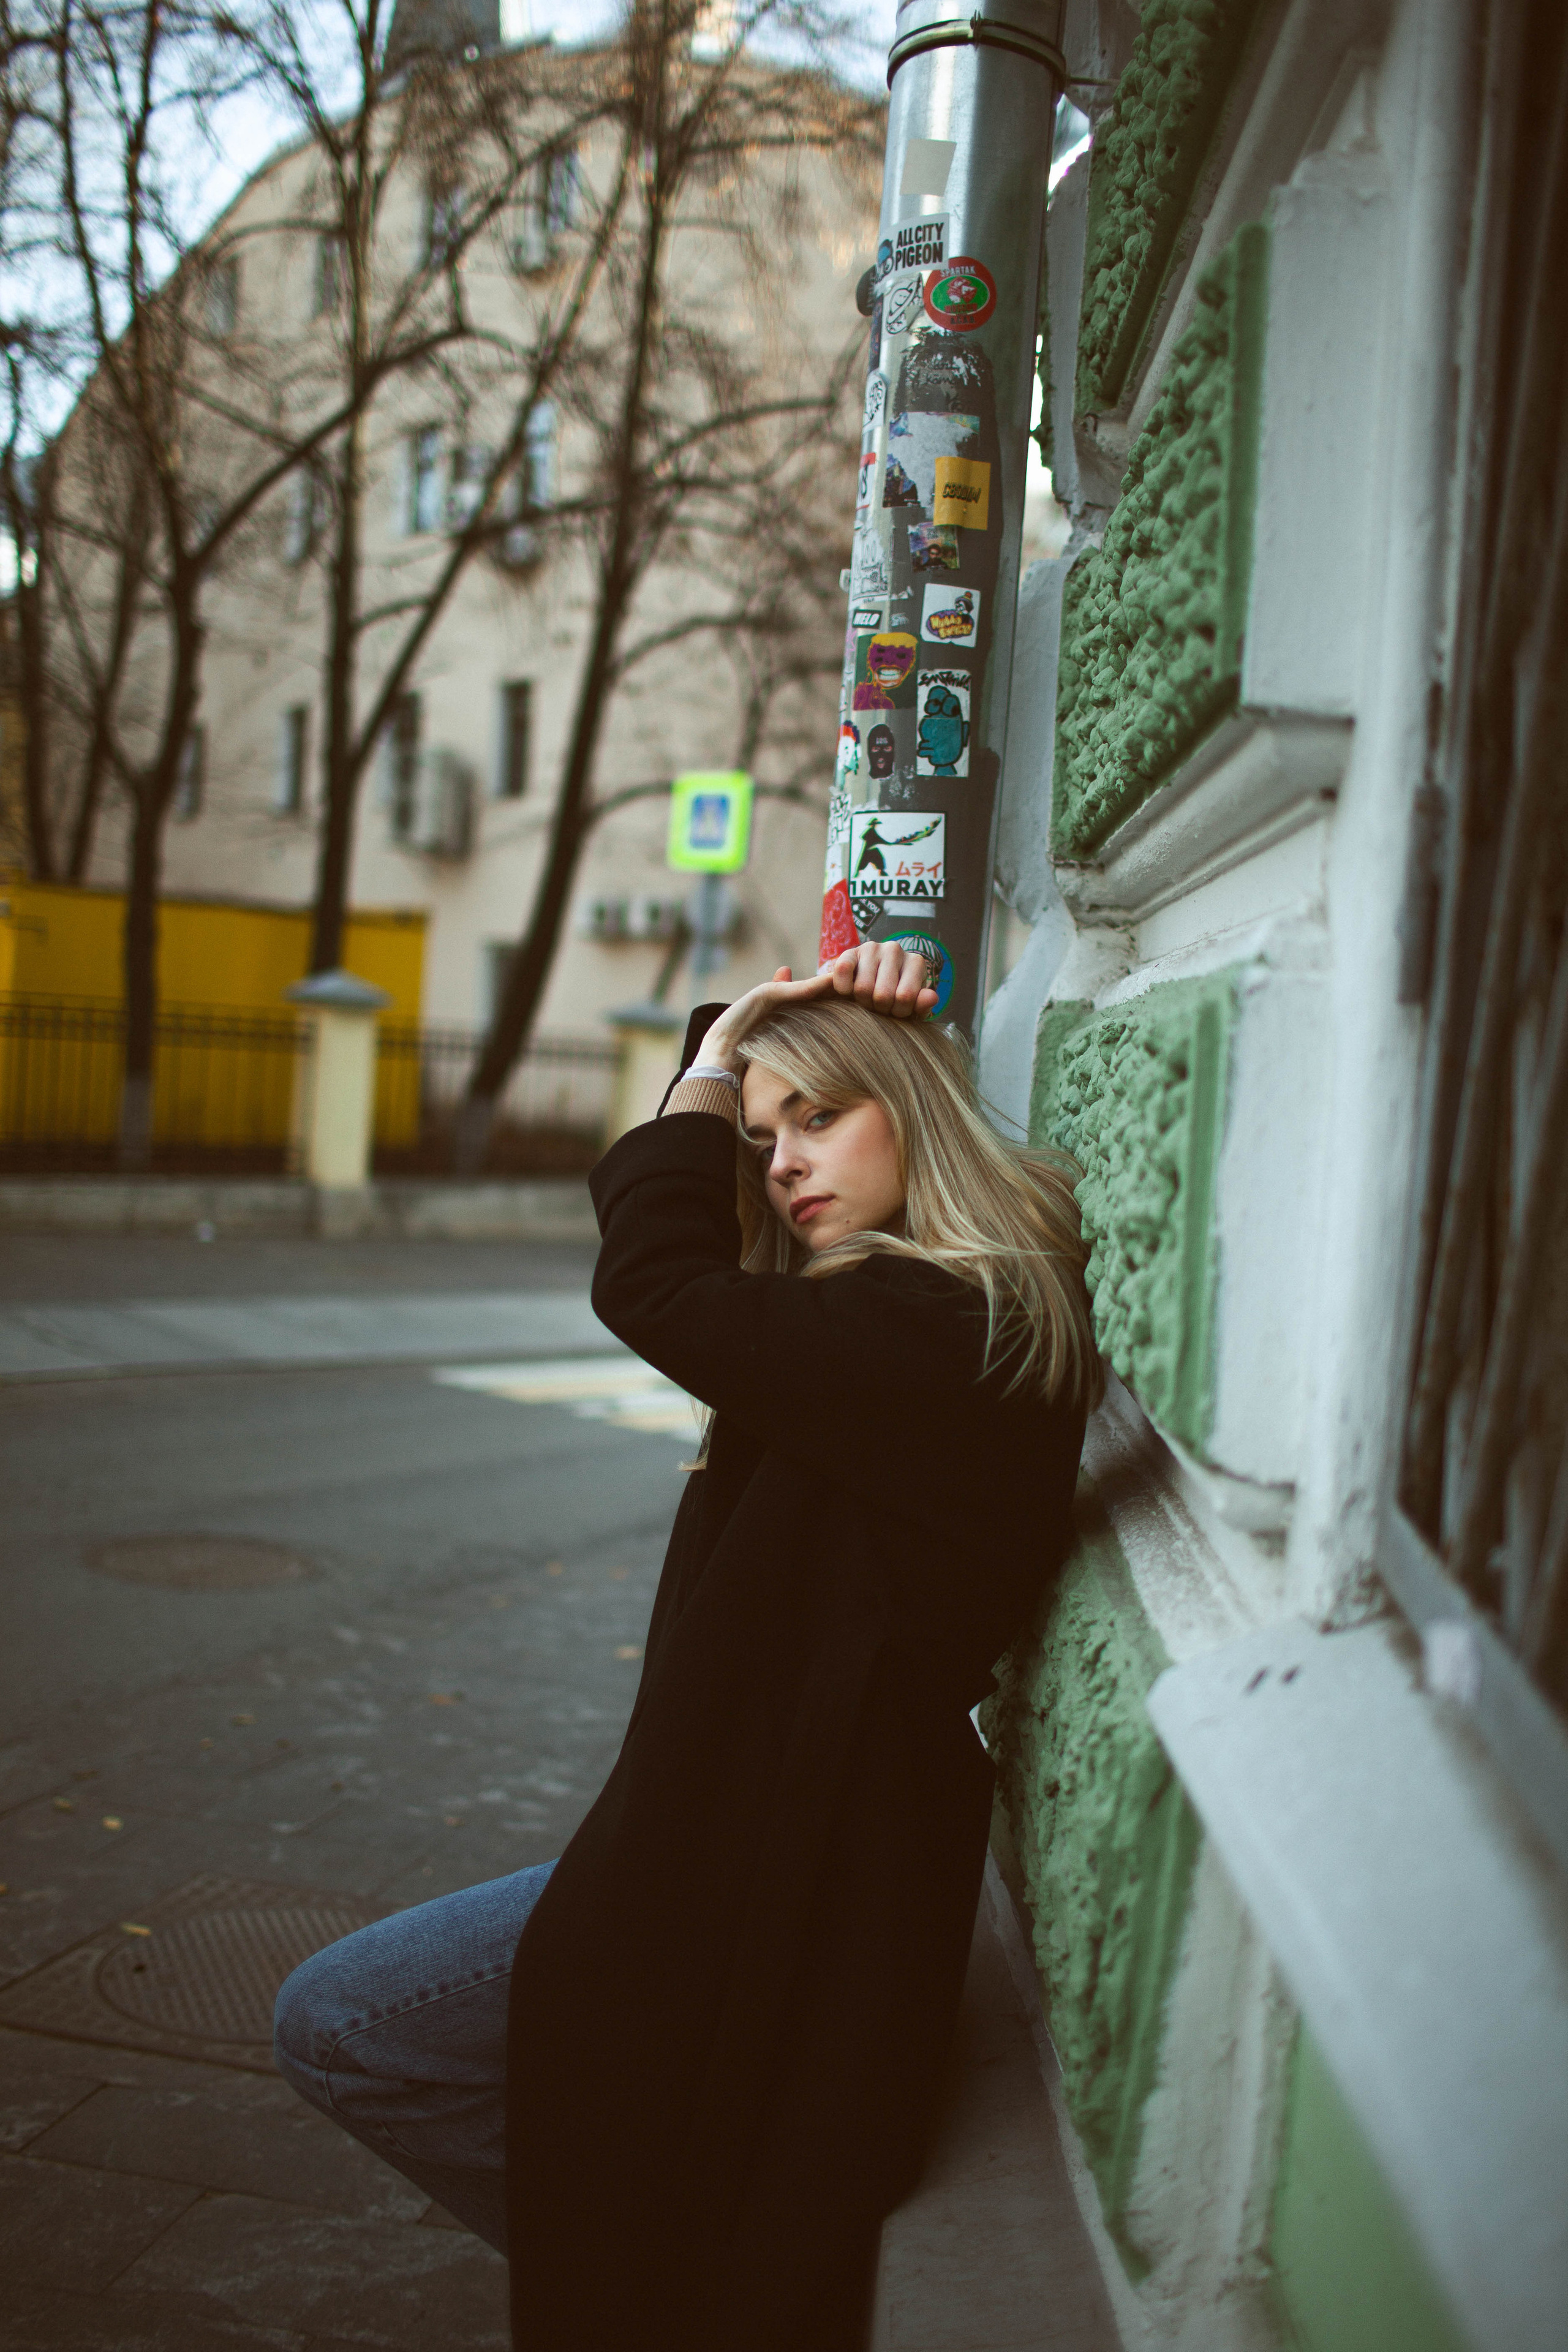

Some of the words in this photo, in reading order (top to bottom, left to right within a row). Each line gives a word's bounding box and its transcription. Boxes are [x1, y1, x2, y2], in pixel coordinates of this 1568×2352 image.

[895, 241, 943, 271] PIGEON
[940, 265, 976, 277] SPARTAK
[895, 861, 942, 878] ムライ
[867, 900, 880, 913] YOU
[853, 914, 864, 929] TER
